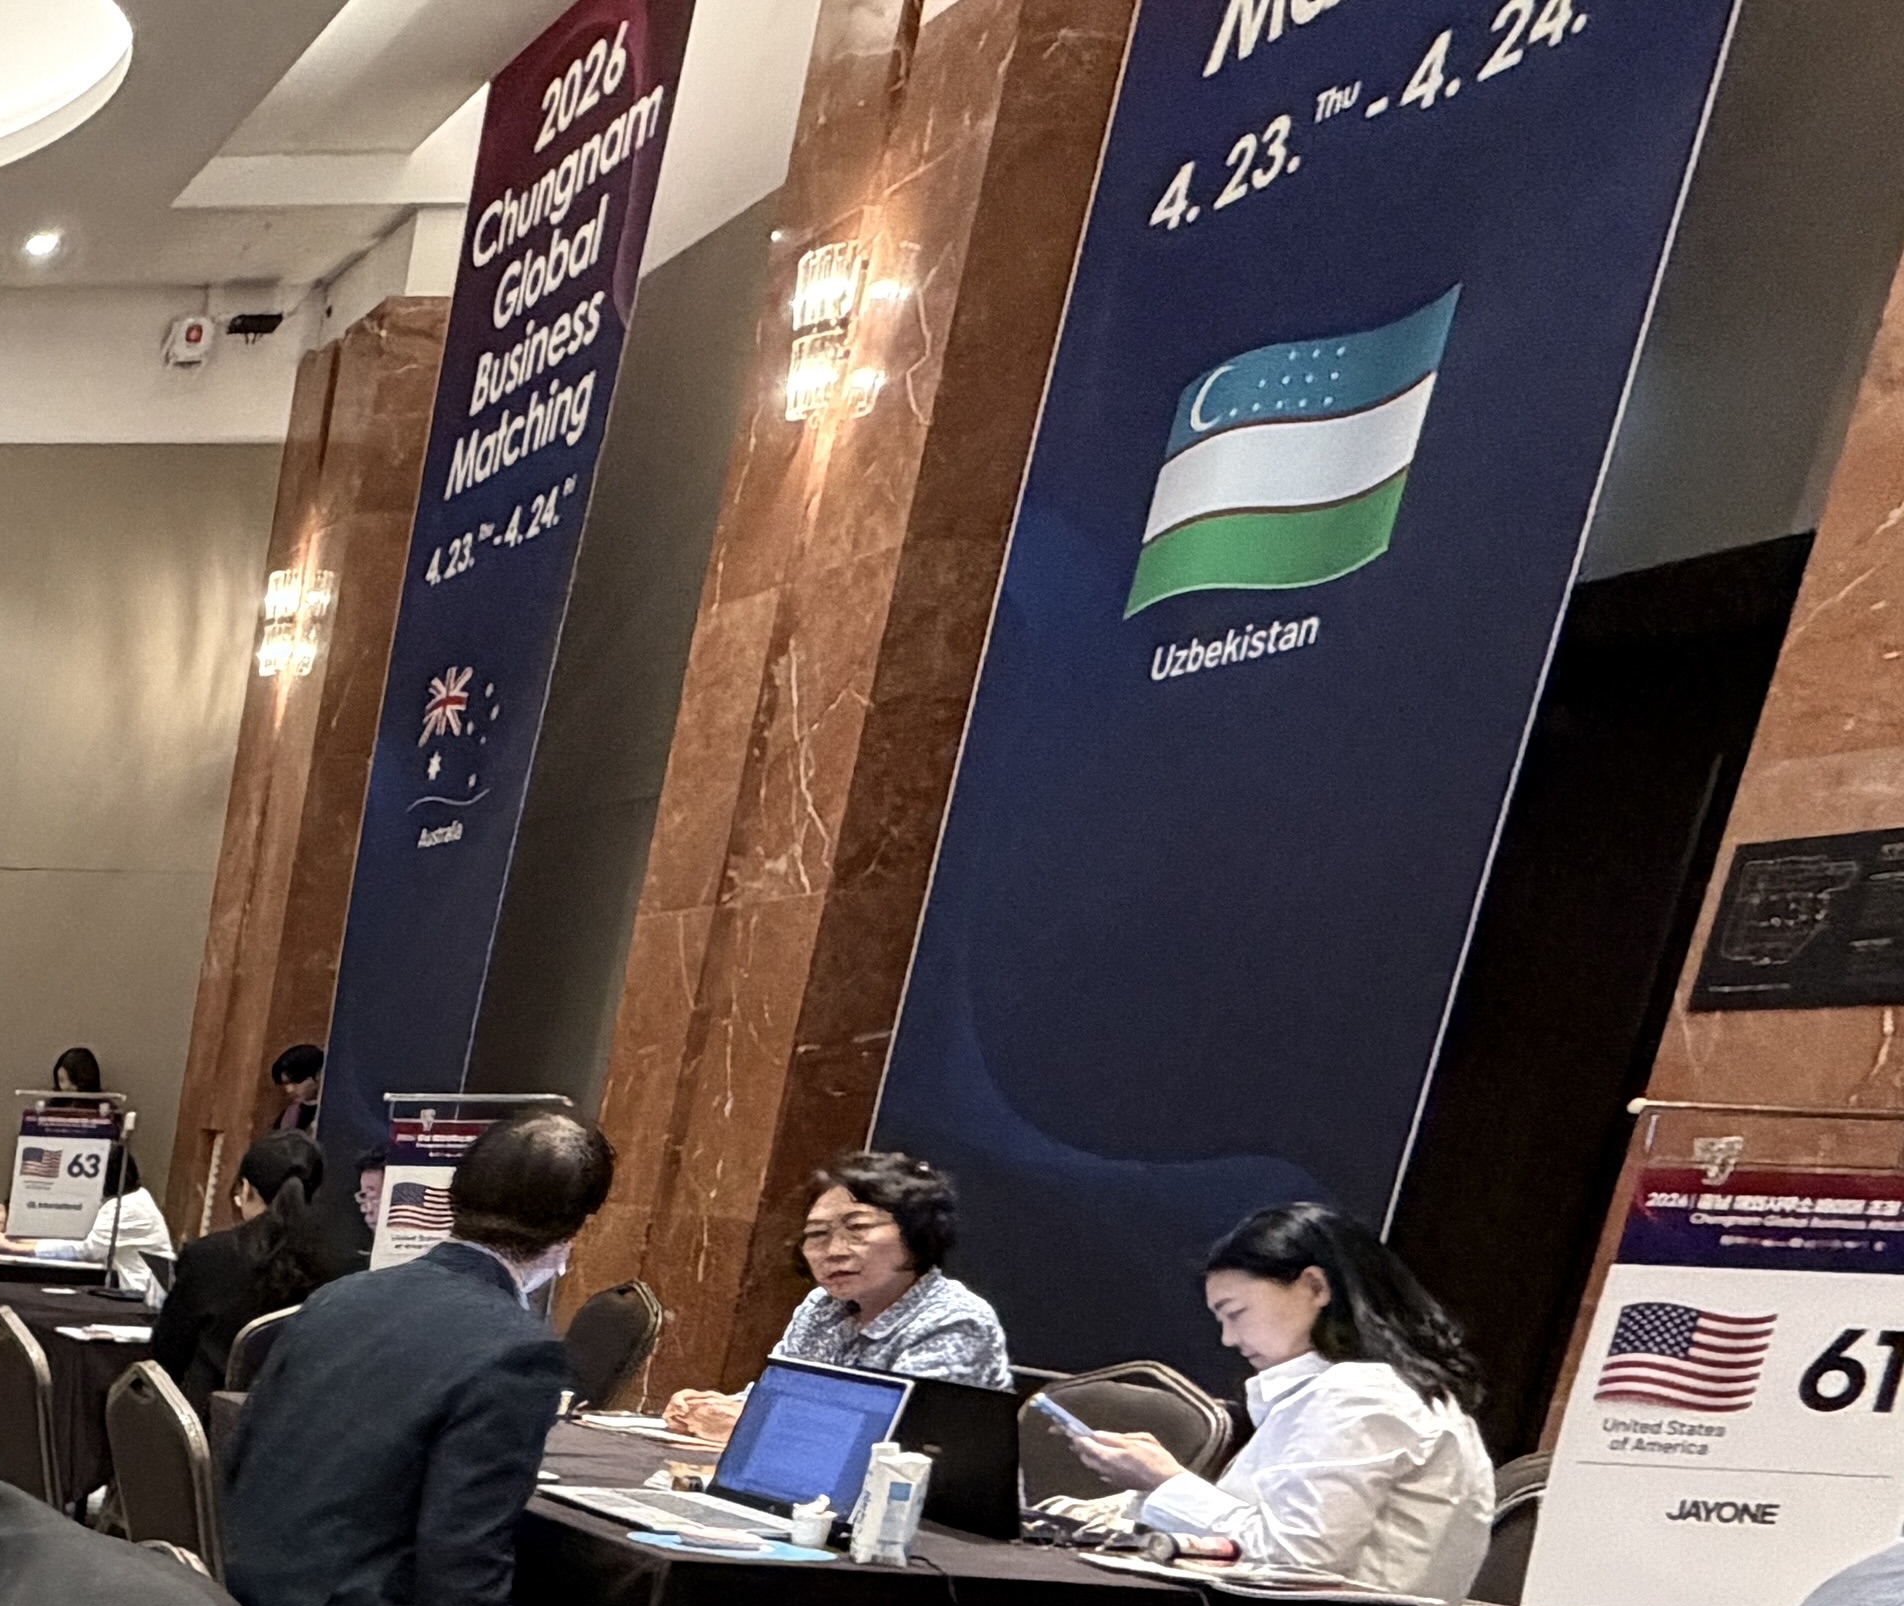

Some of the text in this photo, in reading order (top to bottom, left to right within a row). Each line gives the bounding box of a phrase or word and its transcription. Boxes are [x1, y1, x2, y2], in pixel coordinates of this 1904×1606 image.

[534, 20, 629, 154] 2026
[1150, 161, 1200, 230] 4.
[1213, 113, 1301, 210] 23.
[1314, 80, 1362, 124] Thu
[1399, 29, 1462, 109] 4.
[473, 85, 664, 268] Chungnam
[493, 193, 610, 329] Global
[469, 290, 605, 416] Business
[444, 369, 596, 501] Matching
[1151, 616, 1320, 681] Uzbekistan
[67, 1153, 101, 1178] 63
[1798, 1328, 1904, 1413] 61
[1602, 1418, 1726, 1437] United States
[1632, 1438, 1708, 1455] America
[1666, 1499, 1780, 1525] JAYONE
